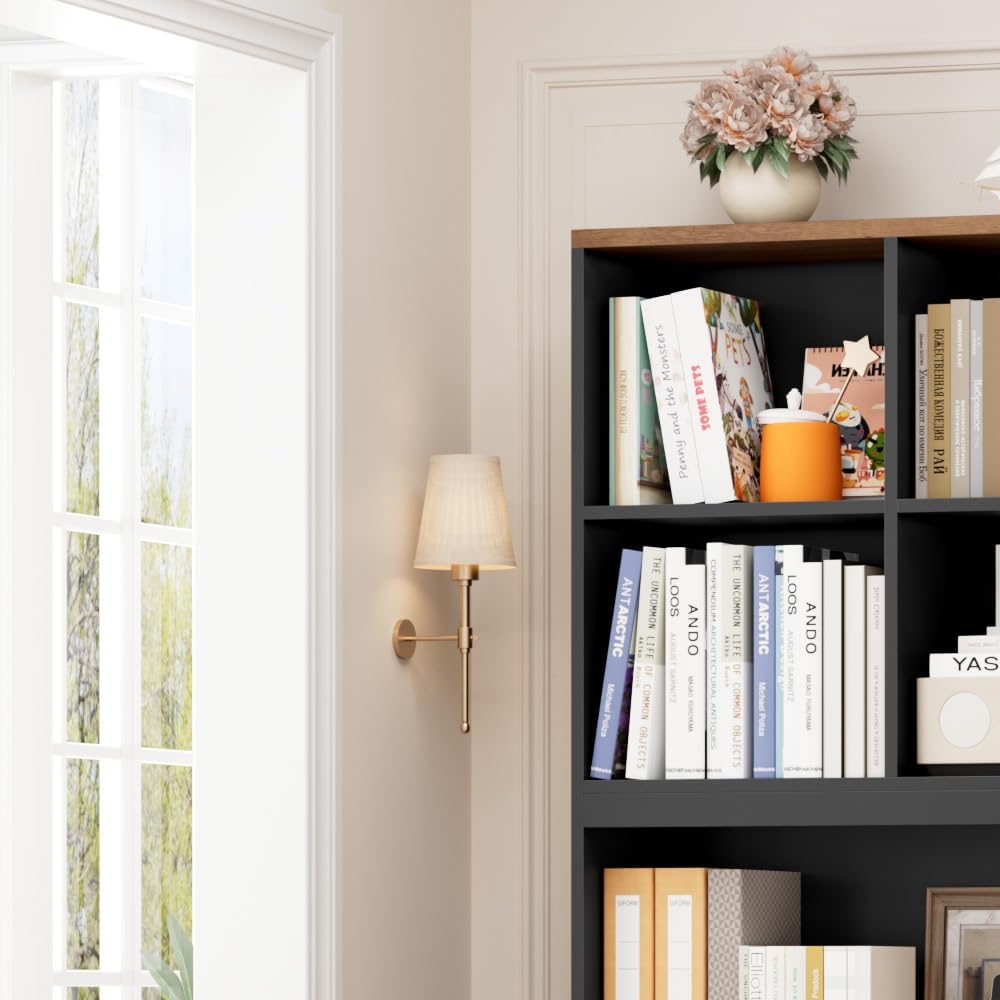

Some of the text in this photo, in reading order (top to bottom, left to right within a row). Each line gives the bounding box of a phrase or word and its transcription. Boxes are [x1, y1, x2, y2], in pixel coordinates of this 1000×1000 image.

[655, 323, 689, 479] Penny and the Monsters
[691, 364, 712, 432] SOME PETS
[919, 368, 928, 408] Уличный
[933, 328, 948, 475] БОЖЕСТВЕННАЯ КОМЕДИЯ РАЙ
[919, 465, 928, 482] Боб
[612, 577, 634, 658] ANTARCTIC
[669, 577, 680, 618] LOOS
[758, 574, 770, 655] ANTARCTIC
[787, 575, 798, 616] LOOS
[687, 604, 699, 656] ANDO
[805, 602, 817, 654] ANDO
[636, 557, 662, 769] THE UNCOMMON LIFE OF COMMON OBJECTS
[732, 554, 742, 768] THE UNCOMMON LIFE OF COMMON OBJECTS
[604, 683, 616, 712] Michael
[759, 681, 768, 712] Michael
[751, 952, 764, 1000] Elliott
